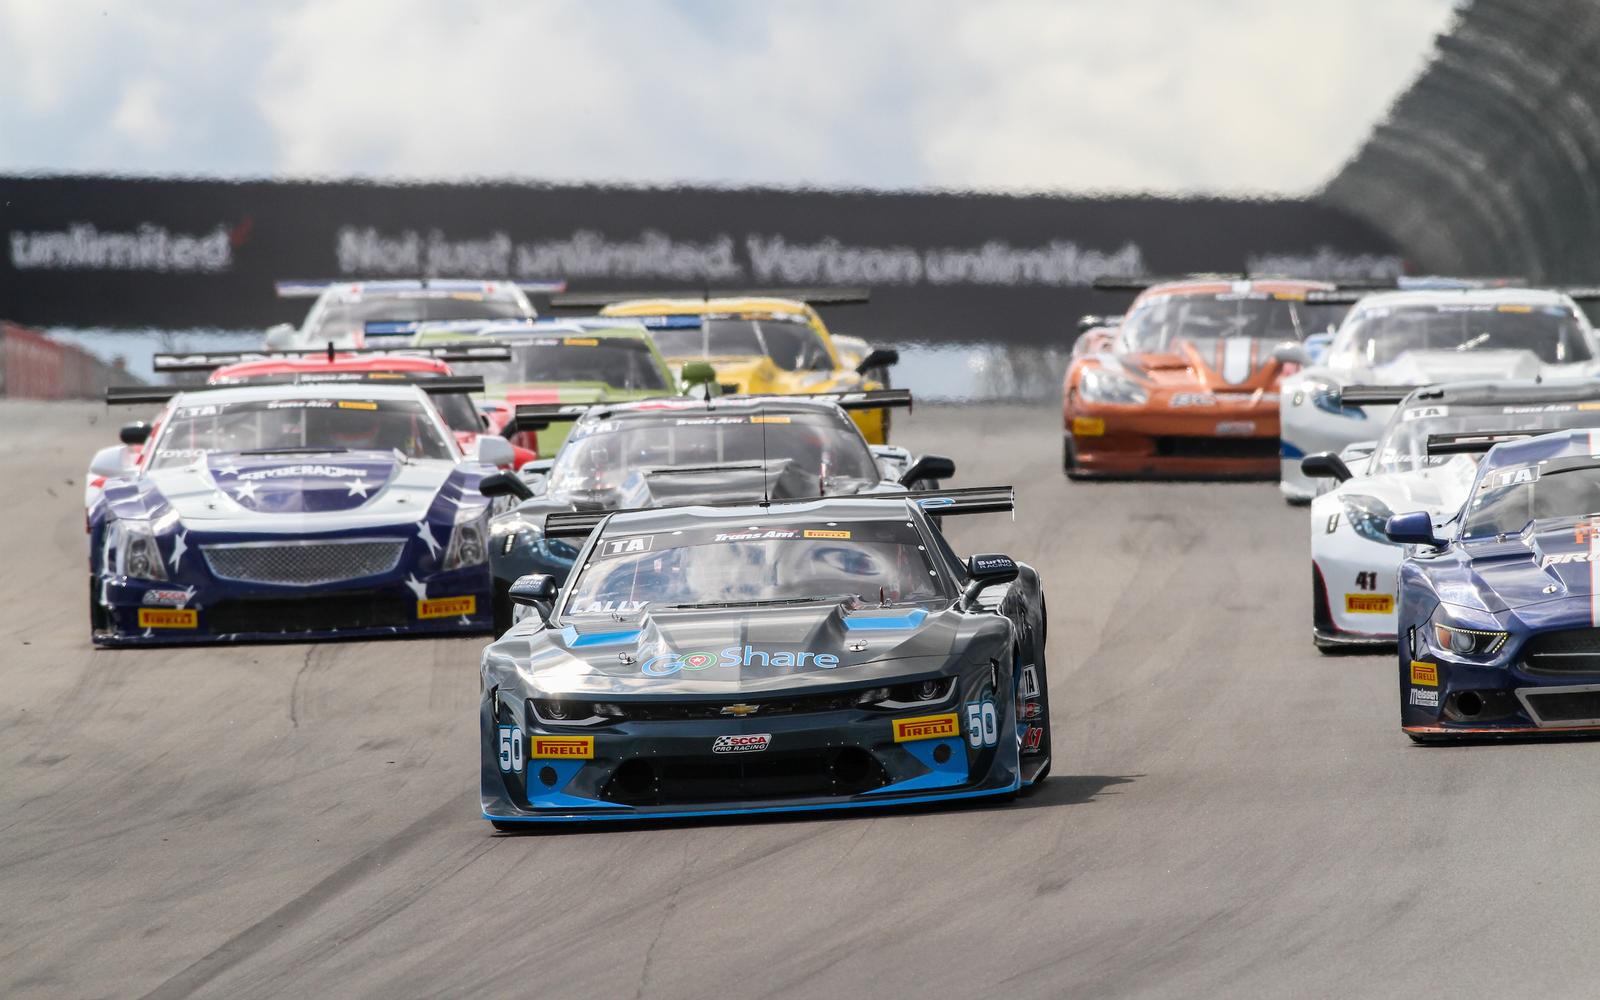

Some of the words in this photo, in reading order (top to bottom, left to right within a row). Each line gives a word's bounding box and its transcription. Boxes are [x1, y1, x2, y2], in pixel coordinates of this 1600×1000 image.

[1412, 408, 1441, 418] TA
[1501, 467, 1533, 486] TA
[714, 533, 762, 542] Trans
[762, 530, 795, 539] Am
[610, 538, 645, 553] TA
[1355, 571, 1377, 591] 41
[569, 600, 649, 614] LALLY
[1413, 666, 1435, 681] PIRELLI
[898, 718, 954, 738] PIRELLI
[966, 701, 998, 749] 50
[536, 740, 589, 755] PIRELLI
[730, 736, 767, 745] SCCA
[498, 726, 523, 772] 50
